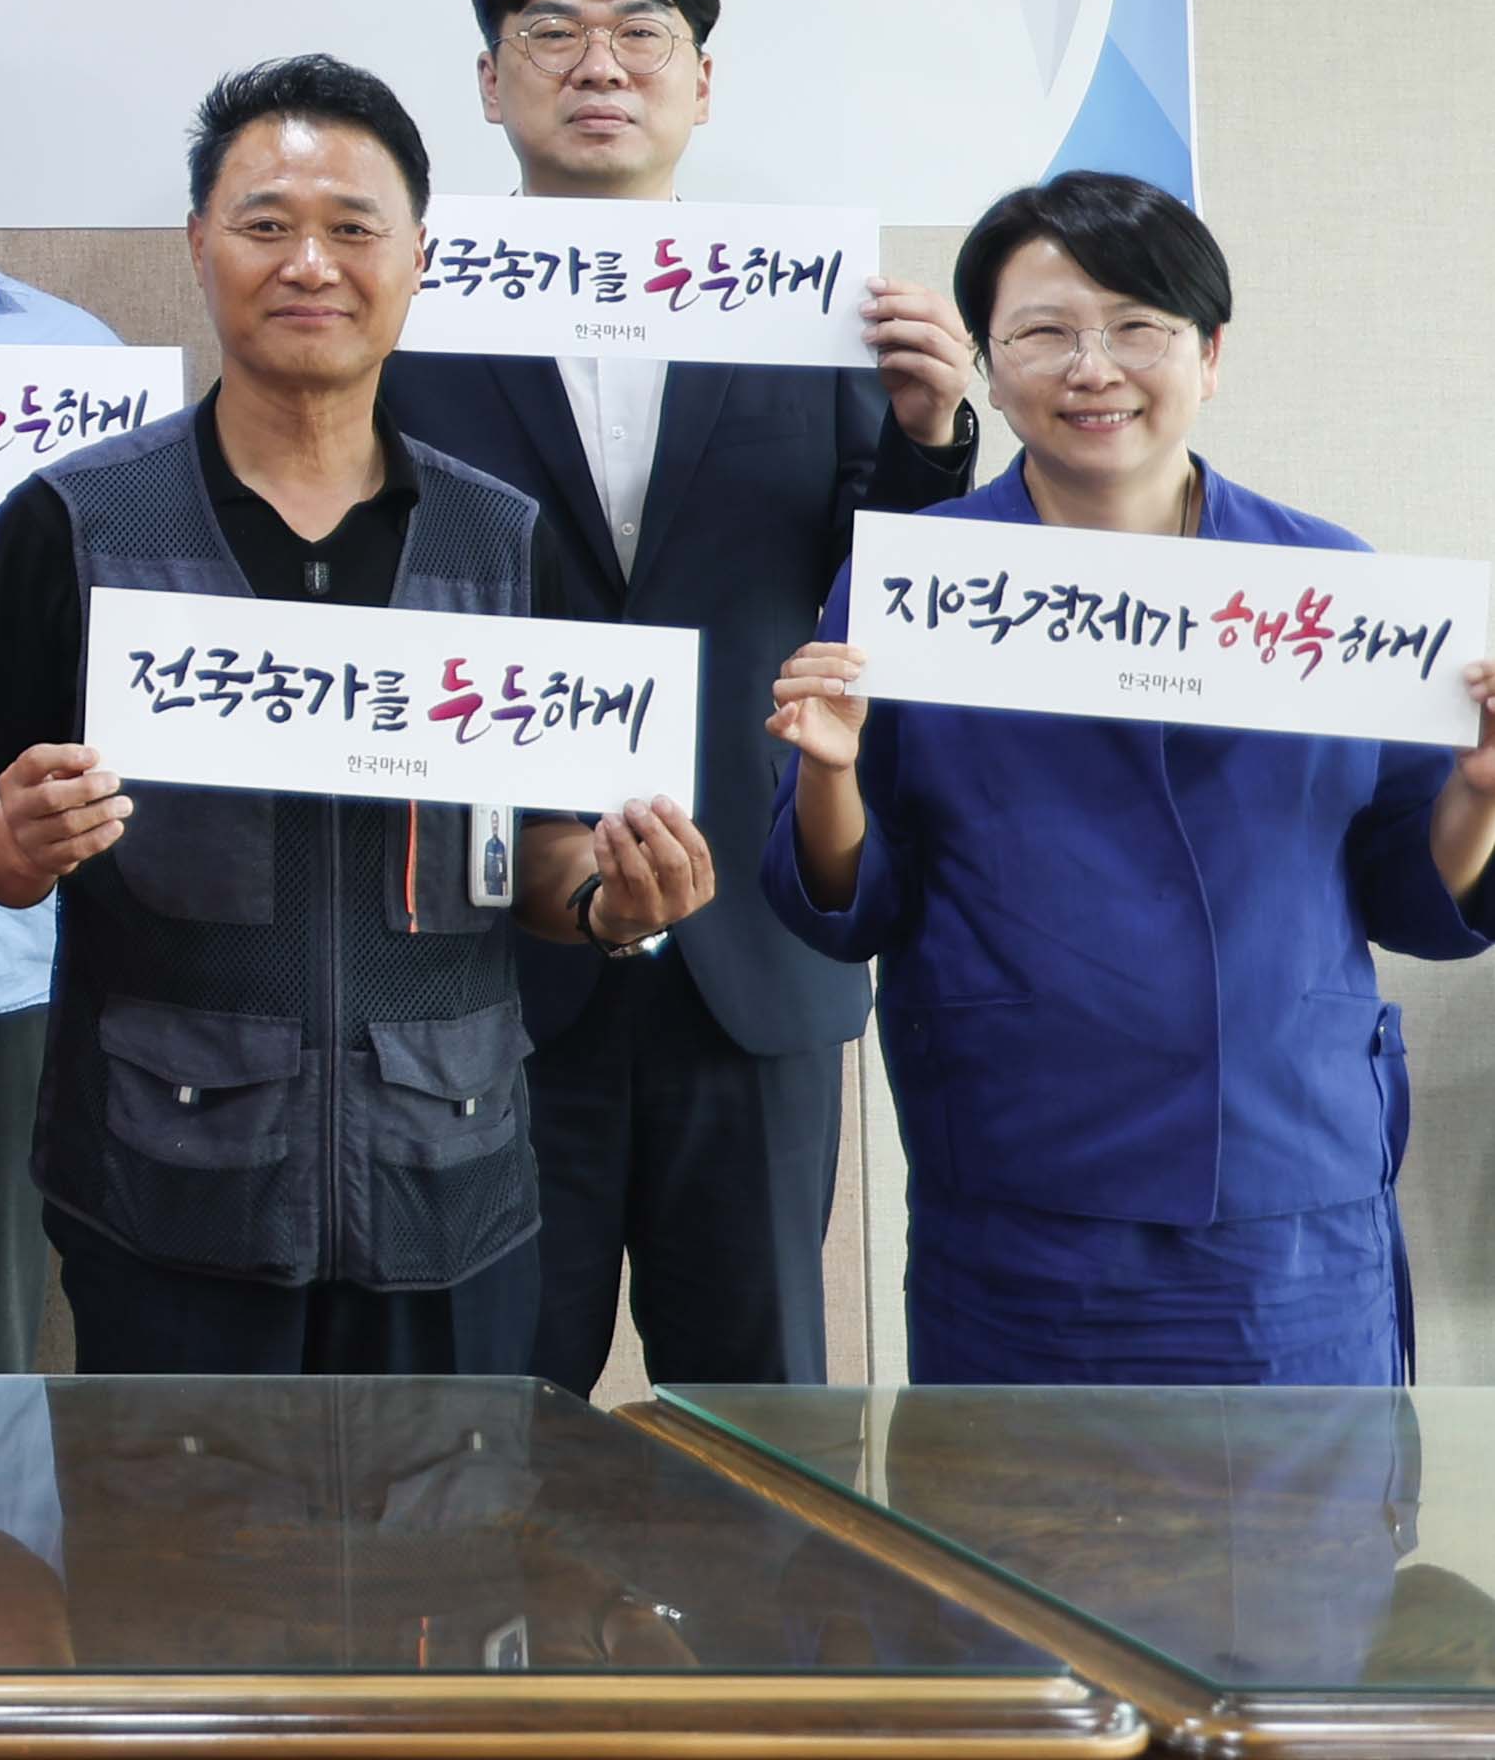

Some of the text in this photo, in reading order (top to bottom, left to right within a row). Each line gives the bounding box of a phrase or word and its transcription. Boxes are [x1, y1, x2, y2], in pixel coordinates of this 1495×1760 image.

[418, 238, 843, 314] 국농가를 든든하게
[576, 324, 645, 340] 한국마사회
[883, 571, 1452, 680] 지역경제가 행복하게
[129, 646, 654, 754] 전국농가를 든든하게
[1119, 673, 1201, 695] 한국마사회
[348, 756, 427, 776] 한국마사회
